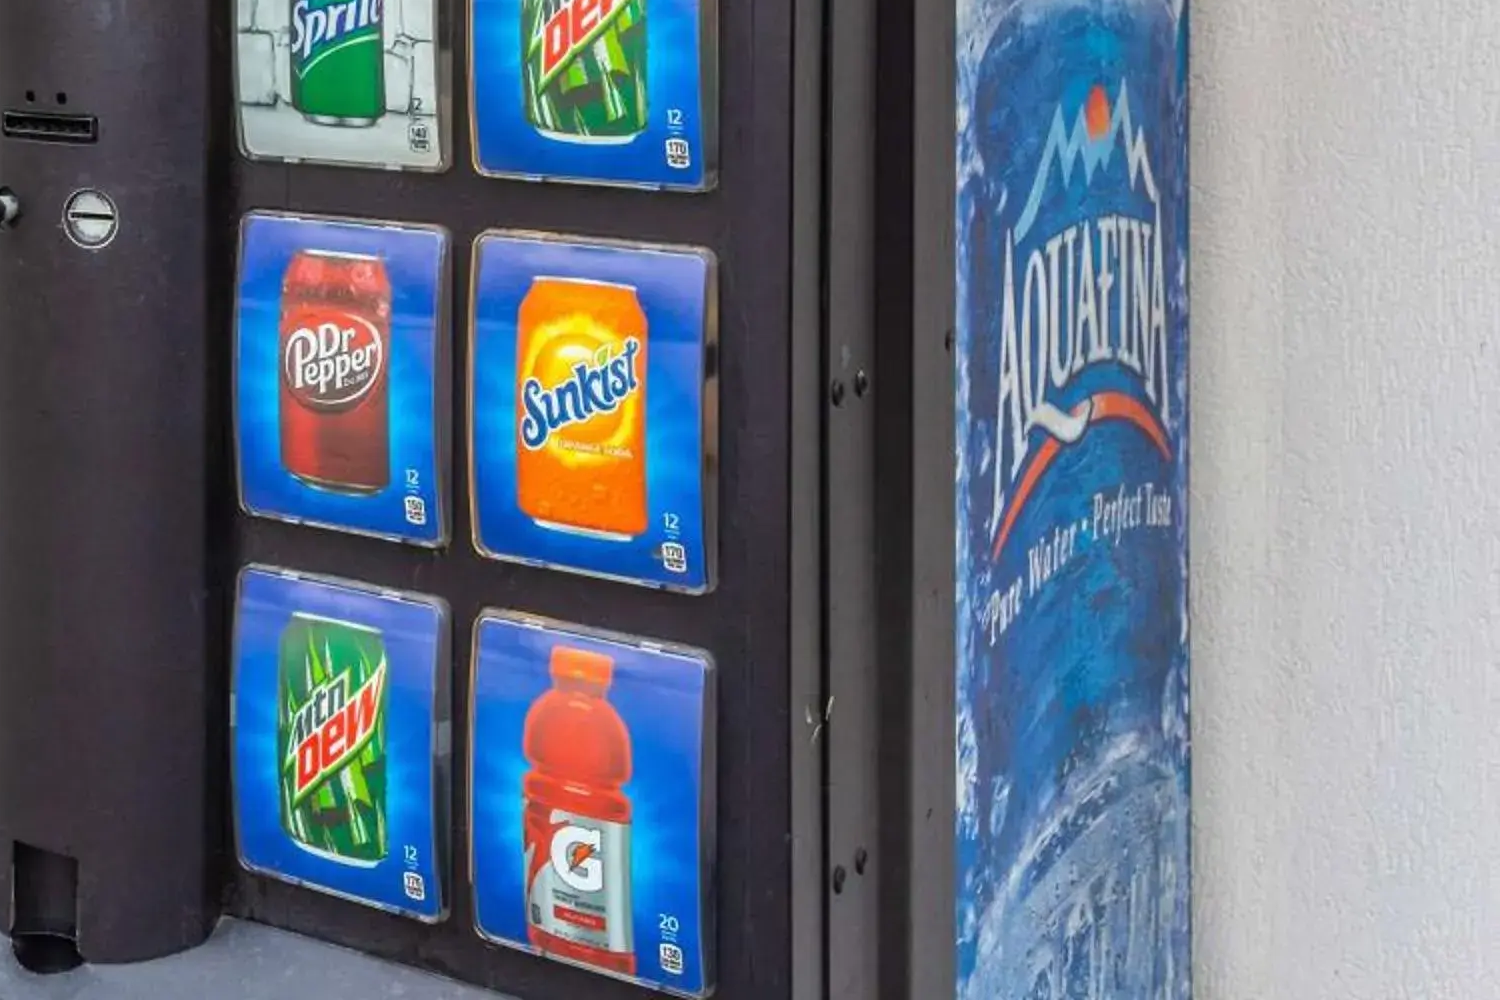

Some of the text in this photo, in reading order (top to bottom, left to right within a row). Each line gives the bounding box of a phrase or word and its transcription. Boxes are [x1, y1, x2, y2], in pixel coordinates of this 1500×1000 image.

[667, 108, 684, 125] 12
[318, 322, 356, 359] Dr
[287, 327, 378, 394] Pepper
[990, 200, 1171, 541] AQUAFINA
[521, 337, 640, 449] Sunkist
[405, 468, 420, 485] 12
[663, 512, 679, 529] 12
[984, 589, 1024, 647] Pure
[1028, 522, 1077, 599] Water
[1092, 482, 1143, 546] Perfect
[403, 844, 418, 861] 12
[551, 825, 603, 893] G
[659, 913, 679, 932] 20
